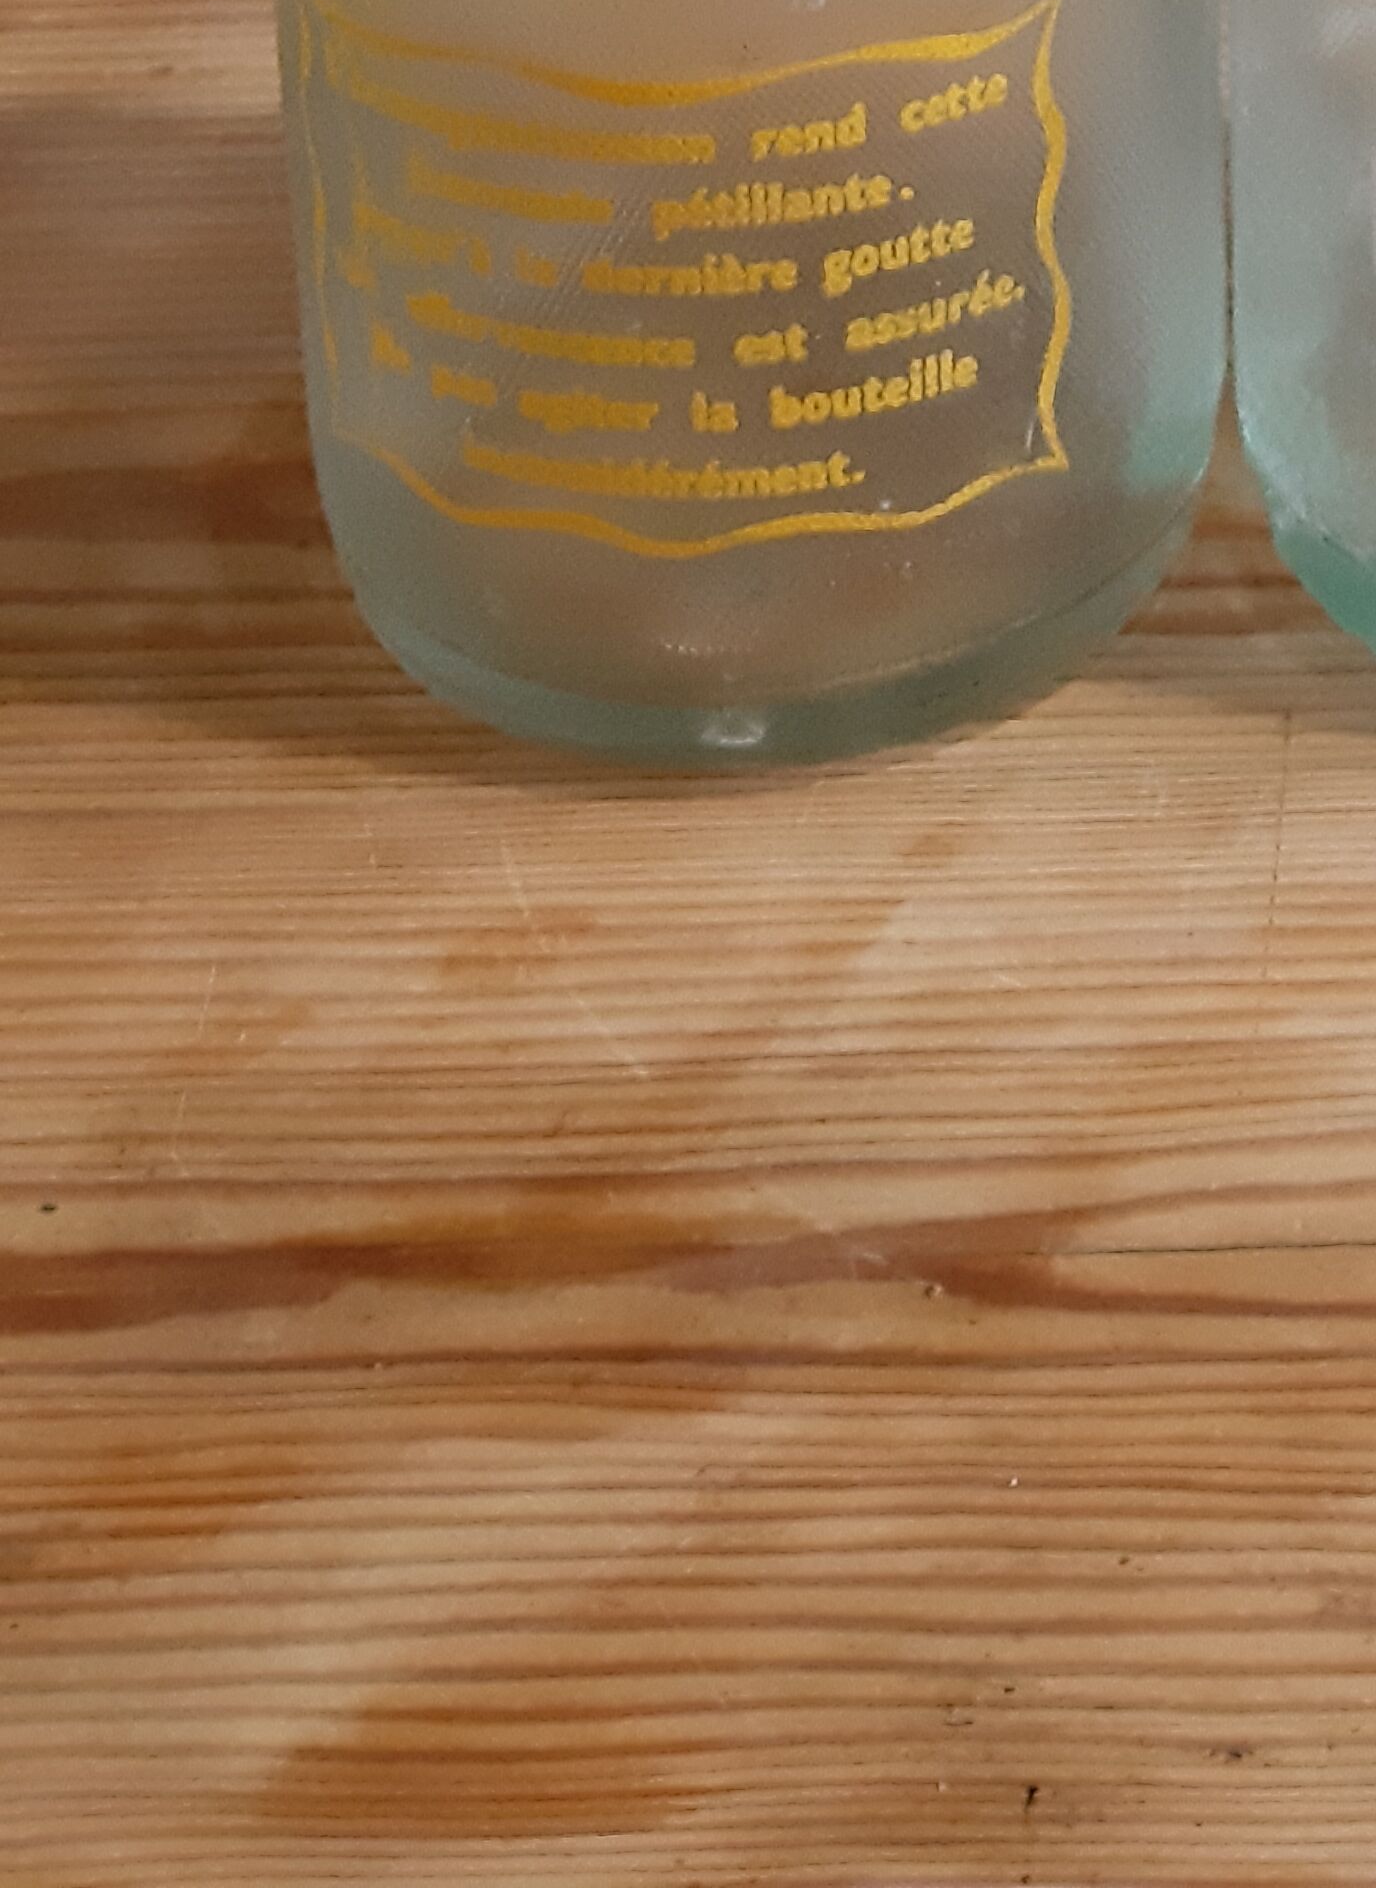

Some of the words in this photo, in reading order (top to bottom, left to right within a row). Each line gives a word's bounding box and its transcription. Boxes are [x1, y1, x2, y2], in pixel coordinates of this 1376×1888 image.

[750, 101, 869, 162] rend
[900, 72, 1008, 132] cette
[822, 218, 976, 298] goutte
[769, 348, 979, 430] bouteille
